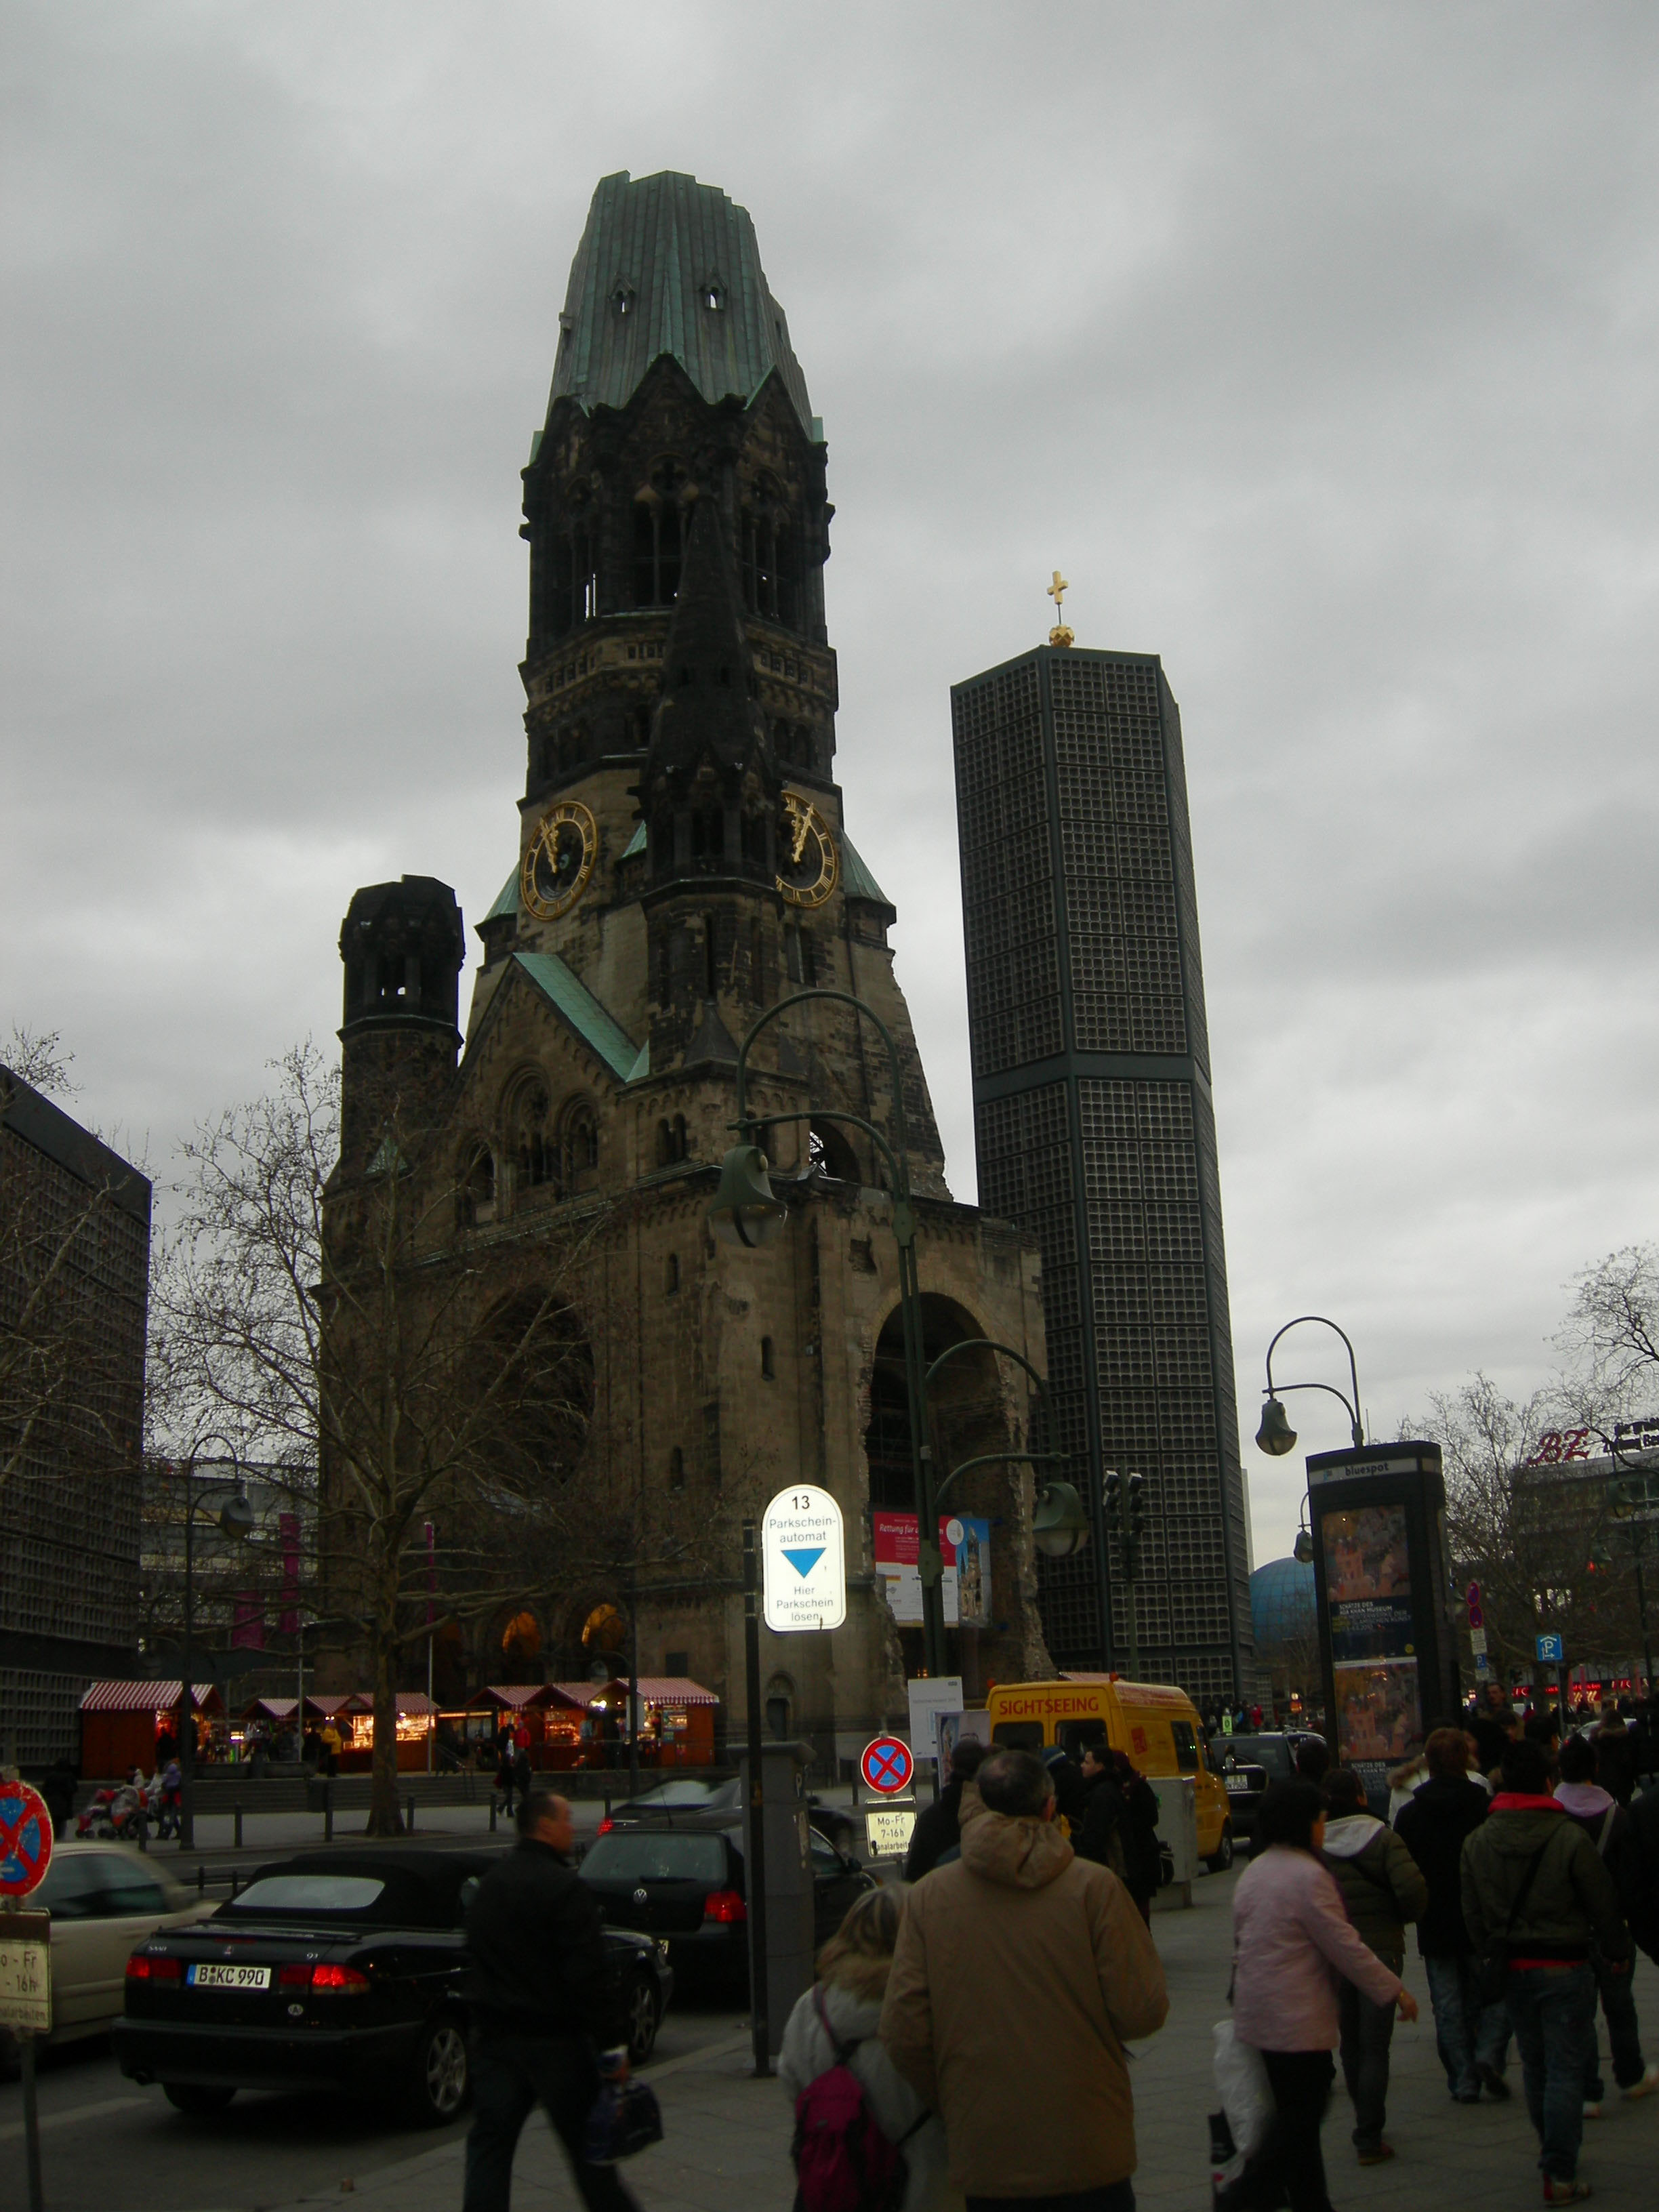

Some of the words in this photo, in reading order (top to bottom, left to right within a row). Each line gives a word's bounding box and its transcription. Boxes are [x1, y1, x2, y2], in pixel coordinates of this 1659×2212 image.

[1345, 1462, 1389, 1477] bluespot
[792, 1496, 810, 1510] 13
[769, 1517, 836, 1529] Parkschein-
[880, 1523, 903, 1534] Rettung
[780, 1531, 827, 1543] automat
[794, 1586, 815, 1595] Hier
[777, 1598, 834, 1609] Parkschein
[791, 1612, 819, 1622] lösen
[1544, 1641, 1554, 1654] P
[999, 1696, 1099, 1715] SIGHTSEEING
[878, 1816, 905, 1825] Mo-Fr
[874, 1841, 909, 1850] analarbeit
[24, 1951, 37, 1968] Fr
[200, 1967, 208, 1982] B
[217, 1969, 234, 1984] KC
[239, 1969, 264, 1986] 990
[17, 1975, 37, 1992] 16h
[0, 2006, 45, 2021] alarbeiten
